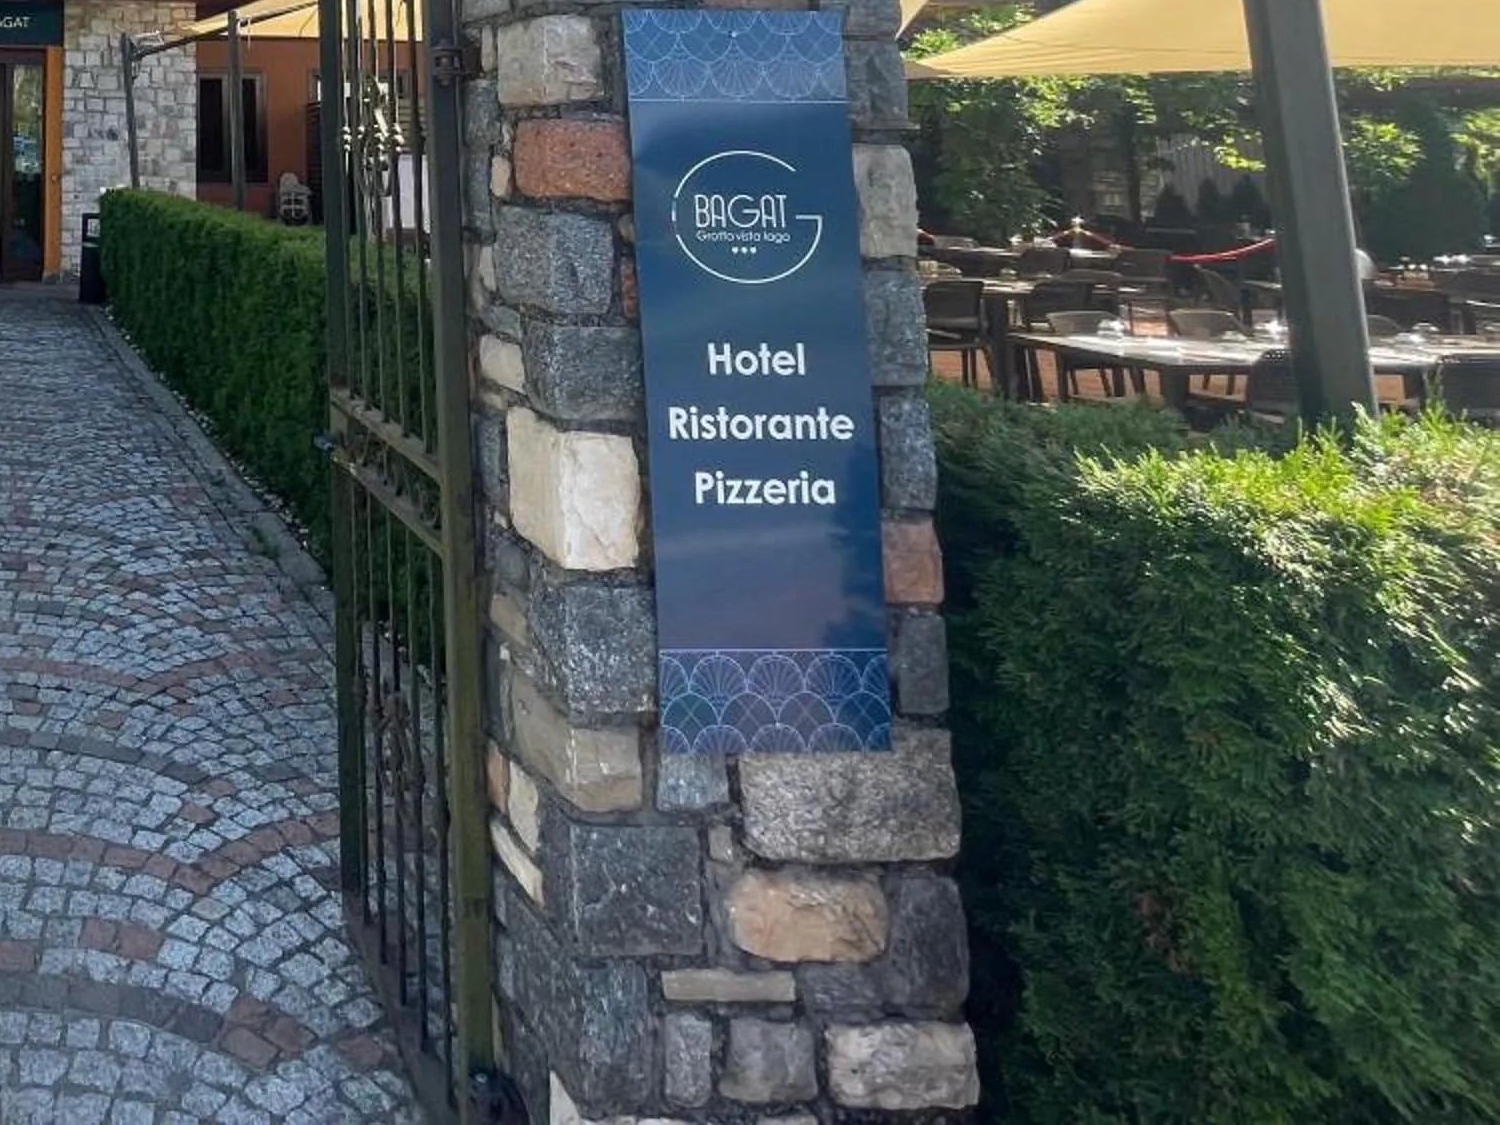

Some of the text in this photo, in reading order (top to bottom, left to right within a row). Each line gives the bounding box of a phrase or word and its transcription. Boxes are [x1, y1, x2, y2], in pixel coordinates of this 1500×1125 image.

[694, 194, 787, 228] BAGAT
[707, 342, 806, 376] Hotel
[668, 407, 855, 441] Ristorante
[695, 472, 836, 505] Pizzeria
